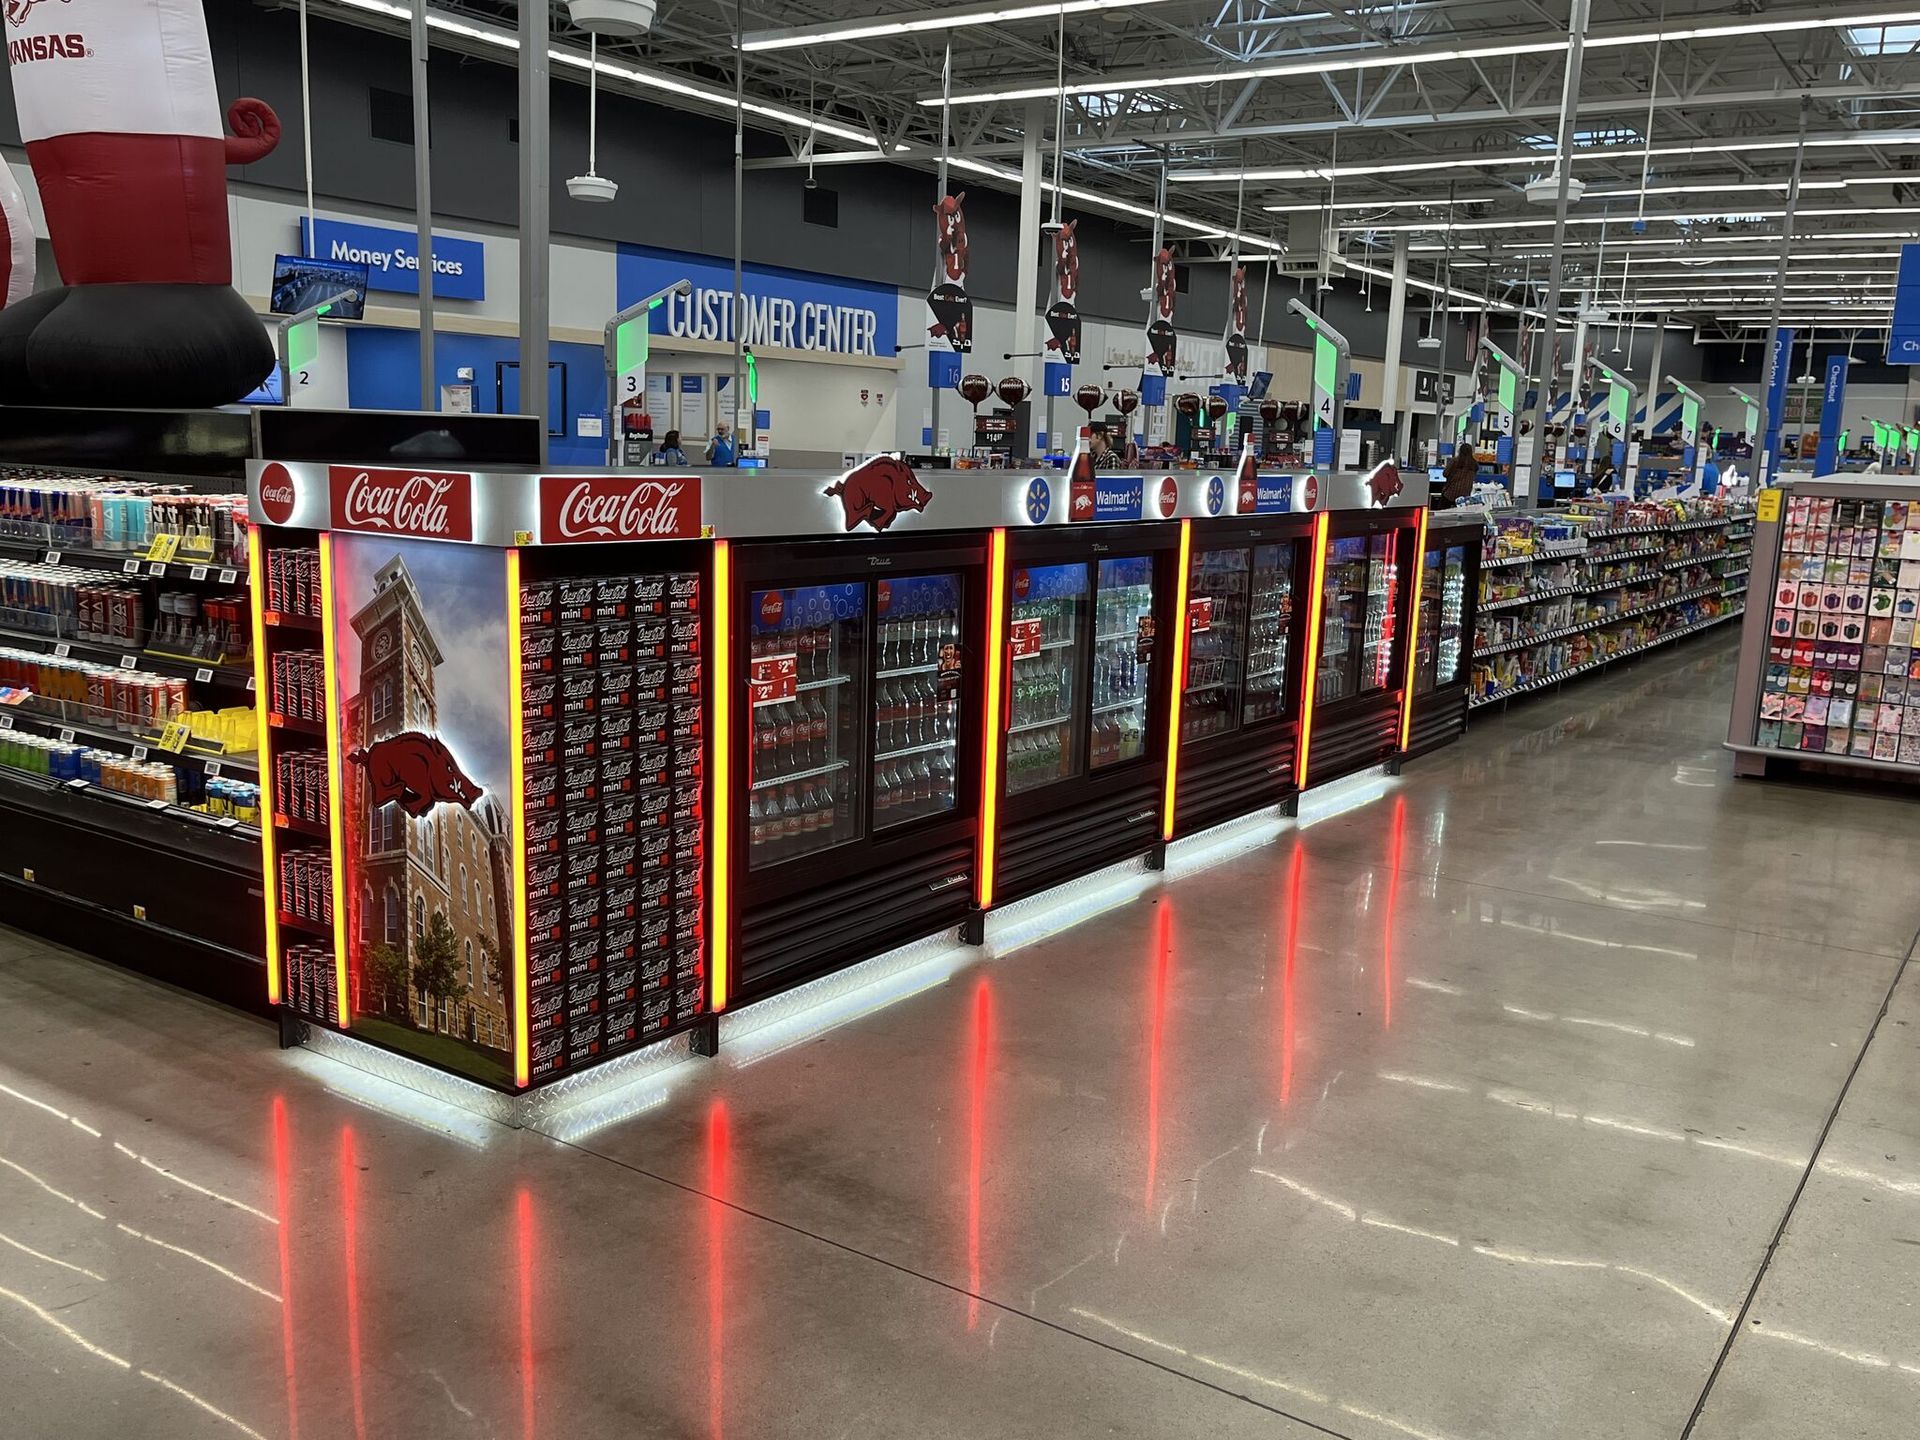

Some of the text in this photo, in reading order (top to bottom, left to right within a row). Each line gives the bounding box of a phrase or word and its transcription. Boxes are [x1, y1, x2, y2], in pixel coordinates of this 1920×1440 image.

[331, 240, 463, 275] Money Serices
[667, 288, 877, 356] CUSTOMER CENTER
[1769, 341, 1782, 387] Checkout
[299, 371, 309, 385] 2
[948, 368, 960, 383] 16
[627, 376, 637, 392] 3
[1061, 377, 1070, 392] 15
[1828, 365, 1841, 402] Checkout
[1320, 397, 1330, 414] 4
[1503, 416, 1510, 429] 5
[1614, 423, 1621, 434] 6
[1686, 430, 1692, 440] 7
[262, 485, 292, 504] Coca-Cola
[1096, 491, 1130, 505] Walmart
[1257, 487, 1282, 500] Walmart
[345, 472, 453, 532] Coca-Cola
[559, 482, 683, 537] Coca-Cola
[635, 603, 652, 612] mini
[671, 599, 687, 608] mini
[562, 609, 580, 619] mini
[597, 606, 615, 615] mini
[521, 612, 540, 623] mini
[637, 647, 654, 657] mini
[672, 642, 687, 652] mini
[563, 655, 582, 665] mini
[600, 650, 618, 660] mini
[521, 660, 540, 670] mini
[638, 691, 655, 700] mini
[672, 686, 688, 695] mini
[565, 700, 583, 710] mini
[601, 695, 619, 705] mini
[522, 706, 541, 717] mini
[674, 727, 690, 736] mini
[639, 733, 656, 743] mini
[602, 739, 620, 749] mini
[565, 746, 583, 757] mini
[524, 752, 543, 764] mini
[675, 768, 691, 778] mini
[640, 775, 656, 785] mini
[604, 782, 621, 792] mini
[566, 791, 584, 801] mini
[525, 799, 544, 810] mini
[675, 809, 690, 818] mini
[641, 818, 658, 827] mini
[606, 825, 623, 835] mini
[568, 834, 586, 845] mini
[528, 843, 547, 855] mini
[676, 849, 692, 859] mini
[643, 859, 659, 868] mini
[607, 868, 623, 878] mini
[568, 878, 587, 889] mini
[530, 888, 548, 899] mini
[676, 889, 692, 900] mini
[642, 899, 658, 909] mini
[607, 911, 624, 920] mini
[570, 922, 588, 932] mini
[531, 931, 549, 943] mini
[676, 930, 692, 940] mini
[642, 940, 658, 950] mini
[607, 953, 624, 962] mini
[570, 965, 588, 975] mini
[677, 970, 693, 980] mini
[532, 975, 550, 987] mini
[643, 981, 659, 991] mini
[608, 995, 625, 1004] mini
[570, 1006, 588, 1017] mini
[677, 1010, 693, 1020] mini
[532, 1020, 551, 1031] mini
[643, 1022, 660, 1032] mini
[608, 1036, 625, 1045] mini
[571, 1049, 588, 1059] mini
[533, 1062, 552, 1074] mini
